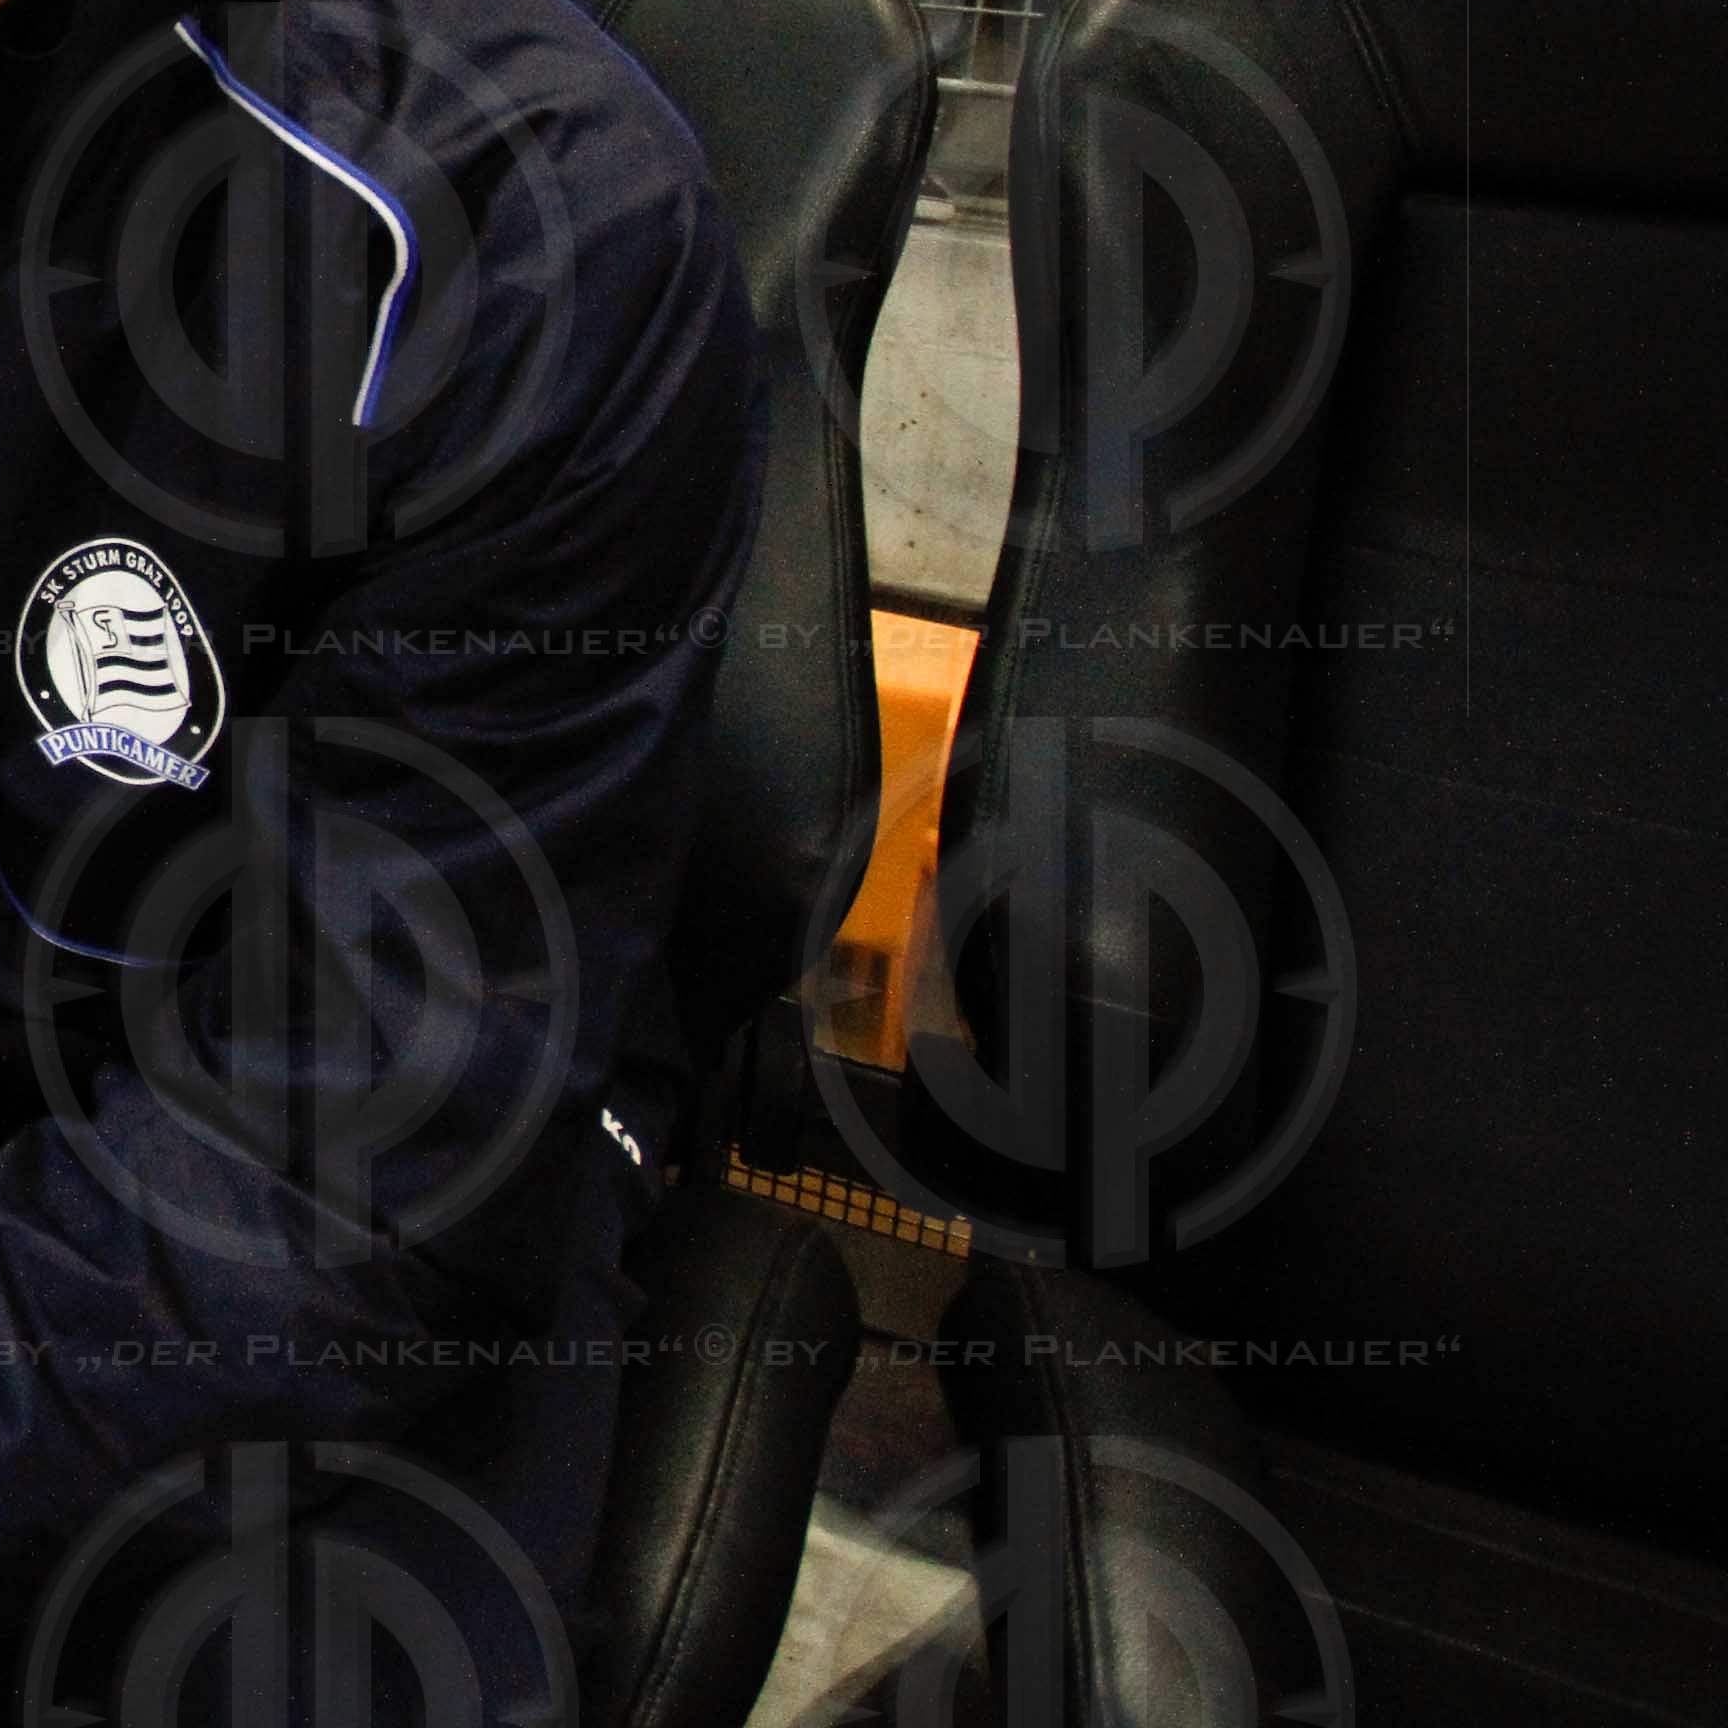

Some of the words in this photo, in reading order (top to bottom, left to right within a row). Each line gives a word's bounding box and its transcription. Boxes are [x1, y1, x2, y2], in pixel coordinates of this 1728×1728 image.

[40, 577, 65, 604] SK
[62, 549, 121, 581] STURM
[125, 550, 164, 588] GRAZ
[46, 726, 199, 786] PUNTIGAMER
